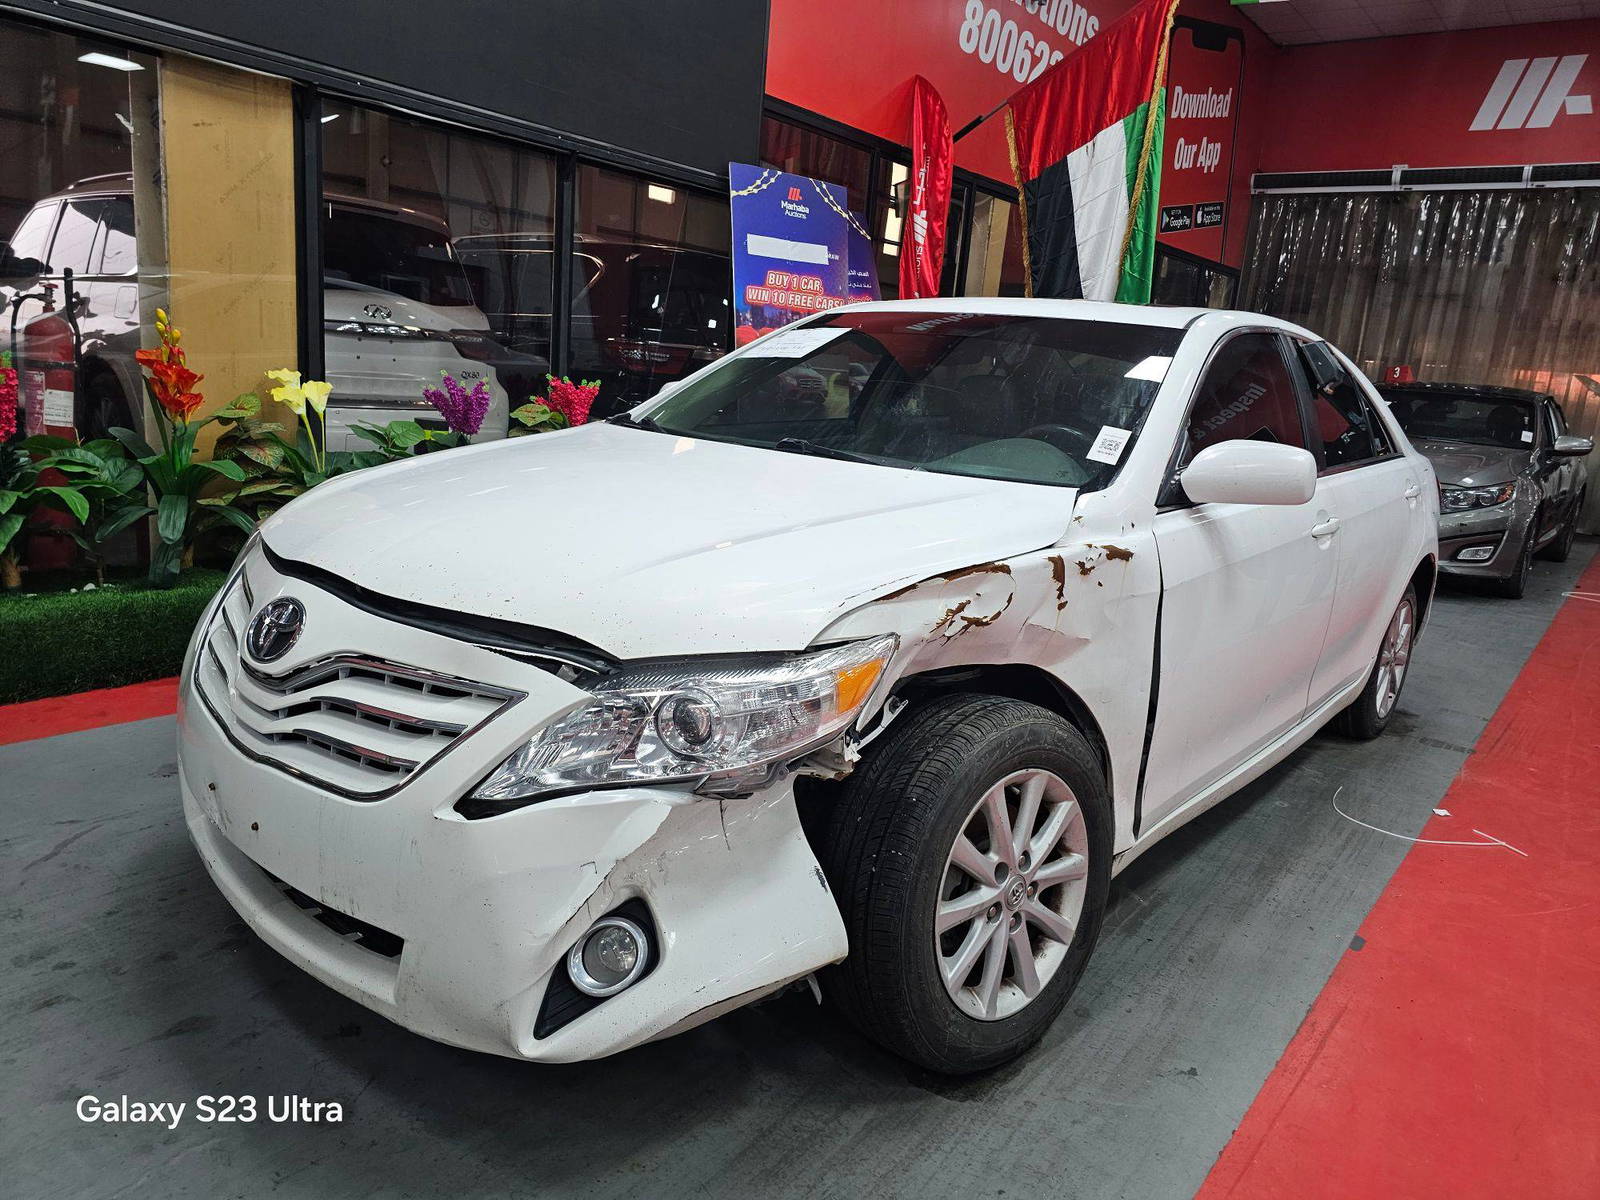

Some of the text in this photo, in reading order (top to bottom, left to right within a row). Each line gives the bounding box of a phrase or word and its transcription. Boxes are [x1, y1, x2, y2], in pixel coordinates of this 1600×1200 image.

[1171, 85, 1232, 119] Download
[1174, 136, 1221, 173] Our App
[781, 200, 809, 214] Marhaba
[785, 209, 807, 219] Auctions
[768, 272, 789, 287] BUY
[792, 276, 798, 289] 1
[748, 288, 769, 302] WIN
[773, 291, 785, 304] 10
[788, 293, 813, 308] FREE
[1393, 366, 1400, 378] 3
